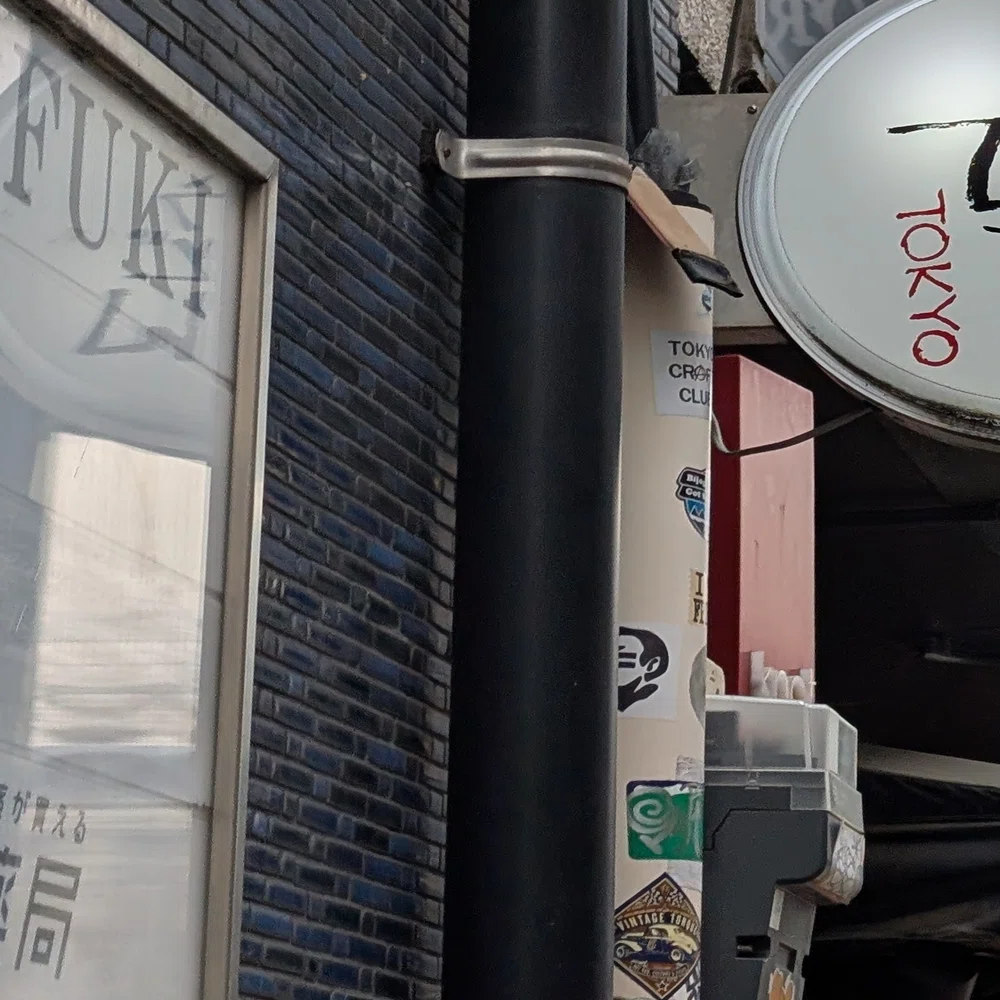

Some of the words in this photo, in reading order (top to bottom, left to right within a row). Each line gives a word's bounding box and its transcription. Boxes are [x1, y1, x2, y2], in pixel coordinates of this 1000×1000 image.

[896, 187, 961, 368] TOKYO
[679, 387, 710, 408] CLU
[0, 784, 87, 845] が買える
[616, 912, 665, 932] VINTAGE
